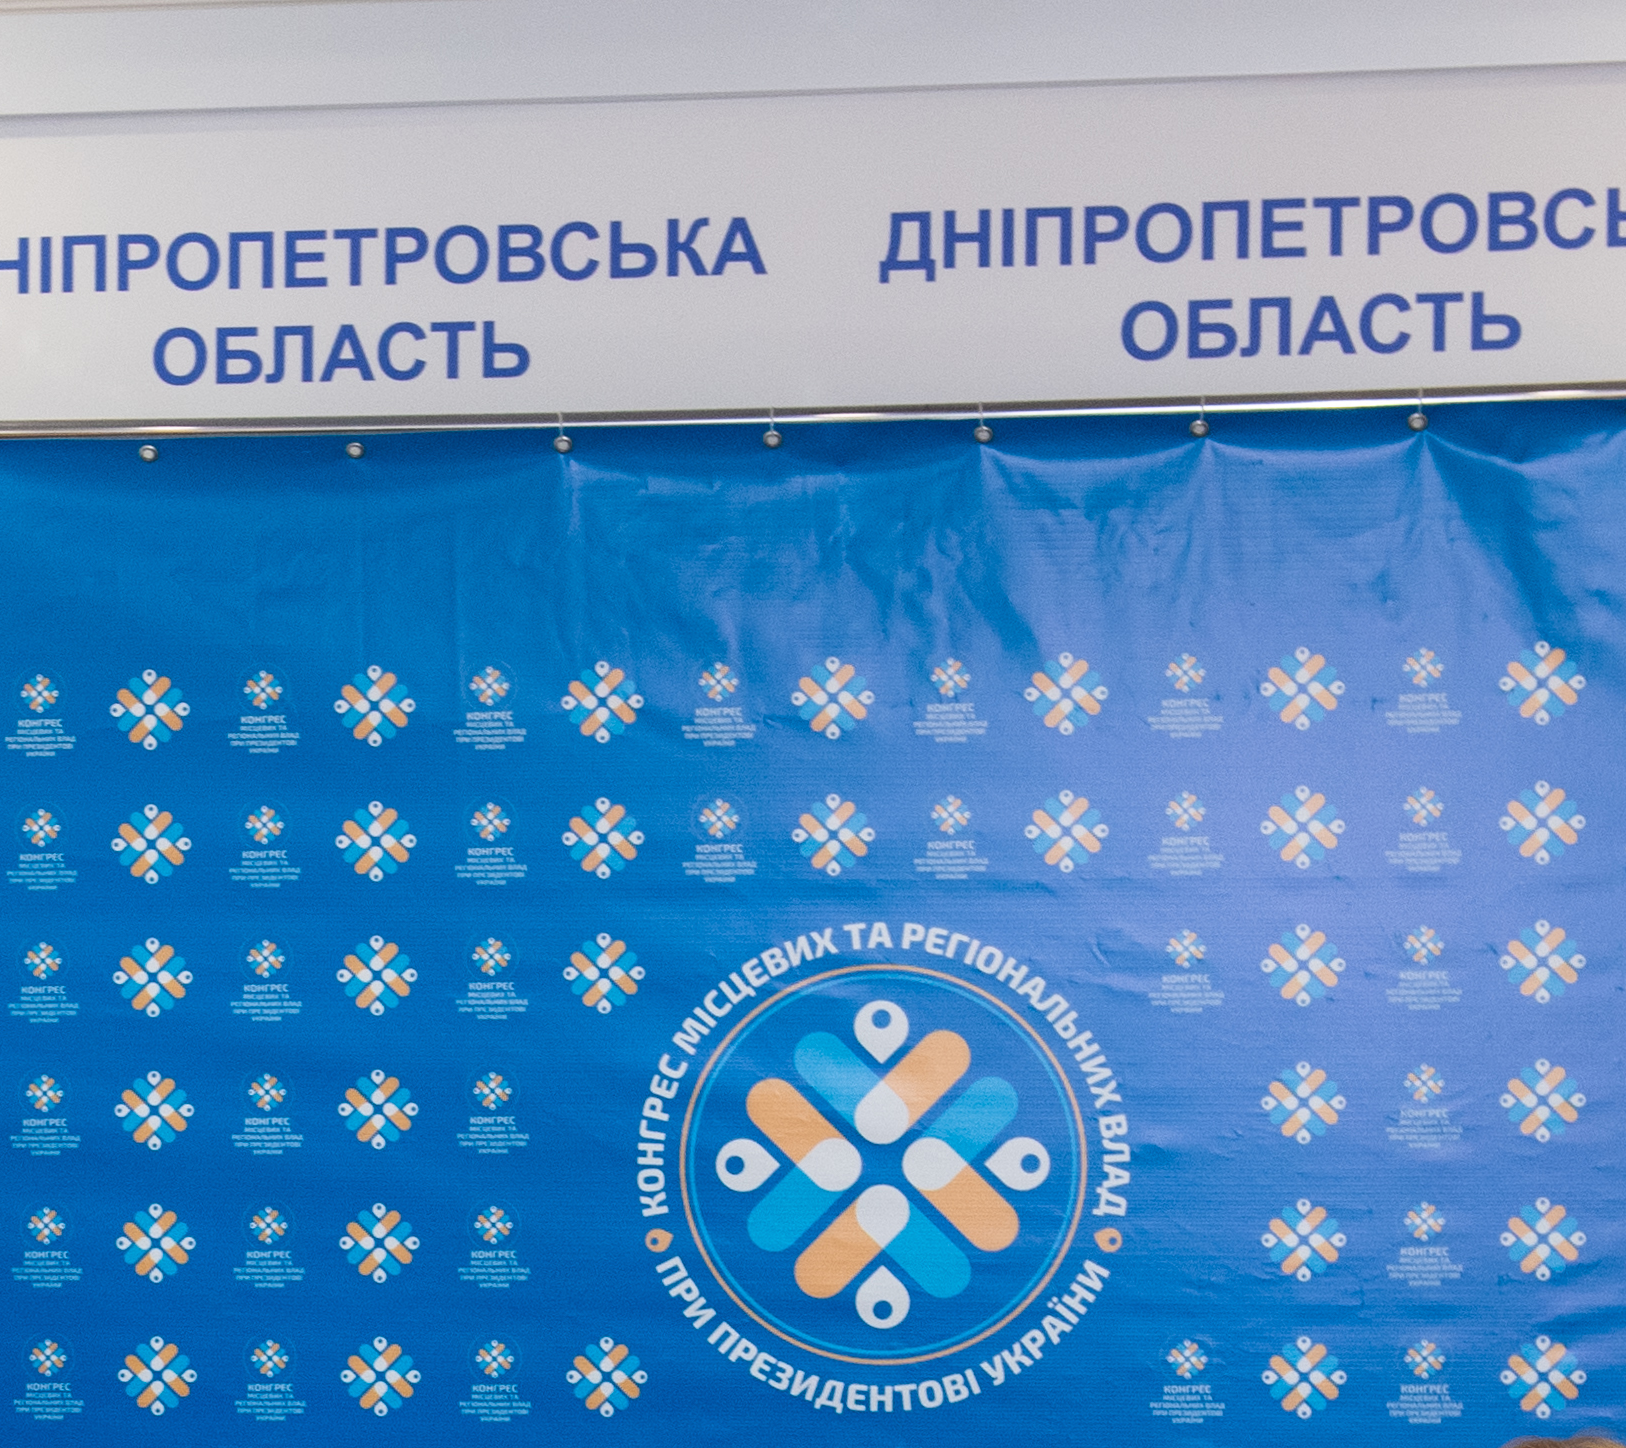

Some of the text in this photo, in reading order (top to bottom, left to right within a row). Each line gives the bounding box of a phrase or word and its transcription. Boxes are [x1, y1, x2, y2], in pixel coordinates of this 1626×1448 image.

[1120, 291, 1522, 362] ОБЛАСТЬ
[152, 320, 531, 386] ОБЛАСТЬ
[466, 711, 513, 720] КОНГРЕС
[467, 847, 514, 856] КОНГРЕС
[468, 981, 515, 990] КОНГРЕС
[637, 922, 1130, 1217] КОНГРЕС МІСЦЕВИХ ТА РЕГІОНАЛЬНИХ ВЛАД
[469, 1115, 516, 1125] КОНГРЕС
[470, 1249, 517, 1259] КОНГРЕС
[655, 1256, 1110, 1413] ПРИ ПРЕЗИДЕНТОВІ УКРАЇНИ
[472, 1383, 518, 1393] КОНГРЕС
